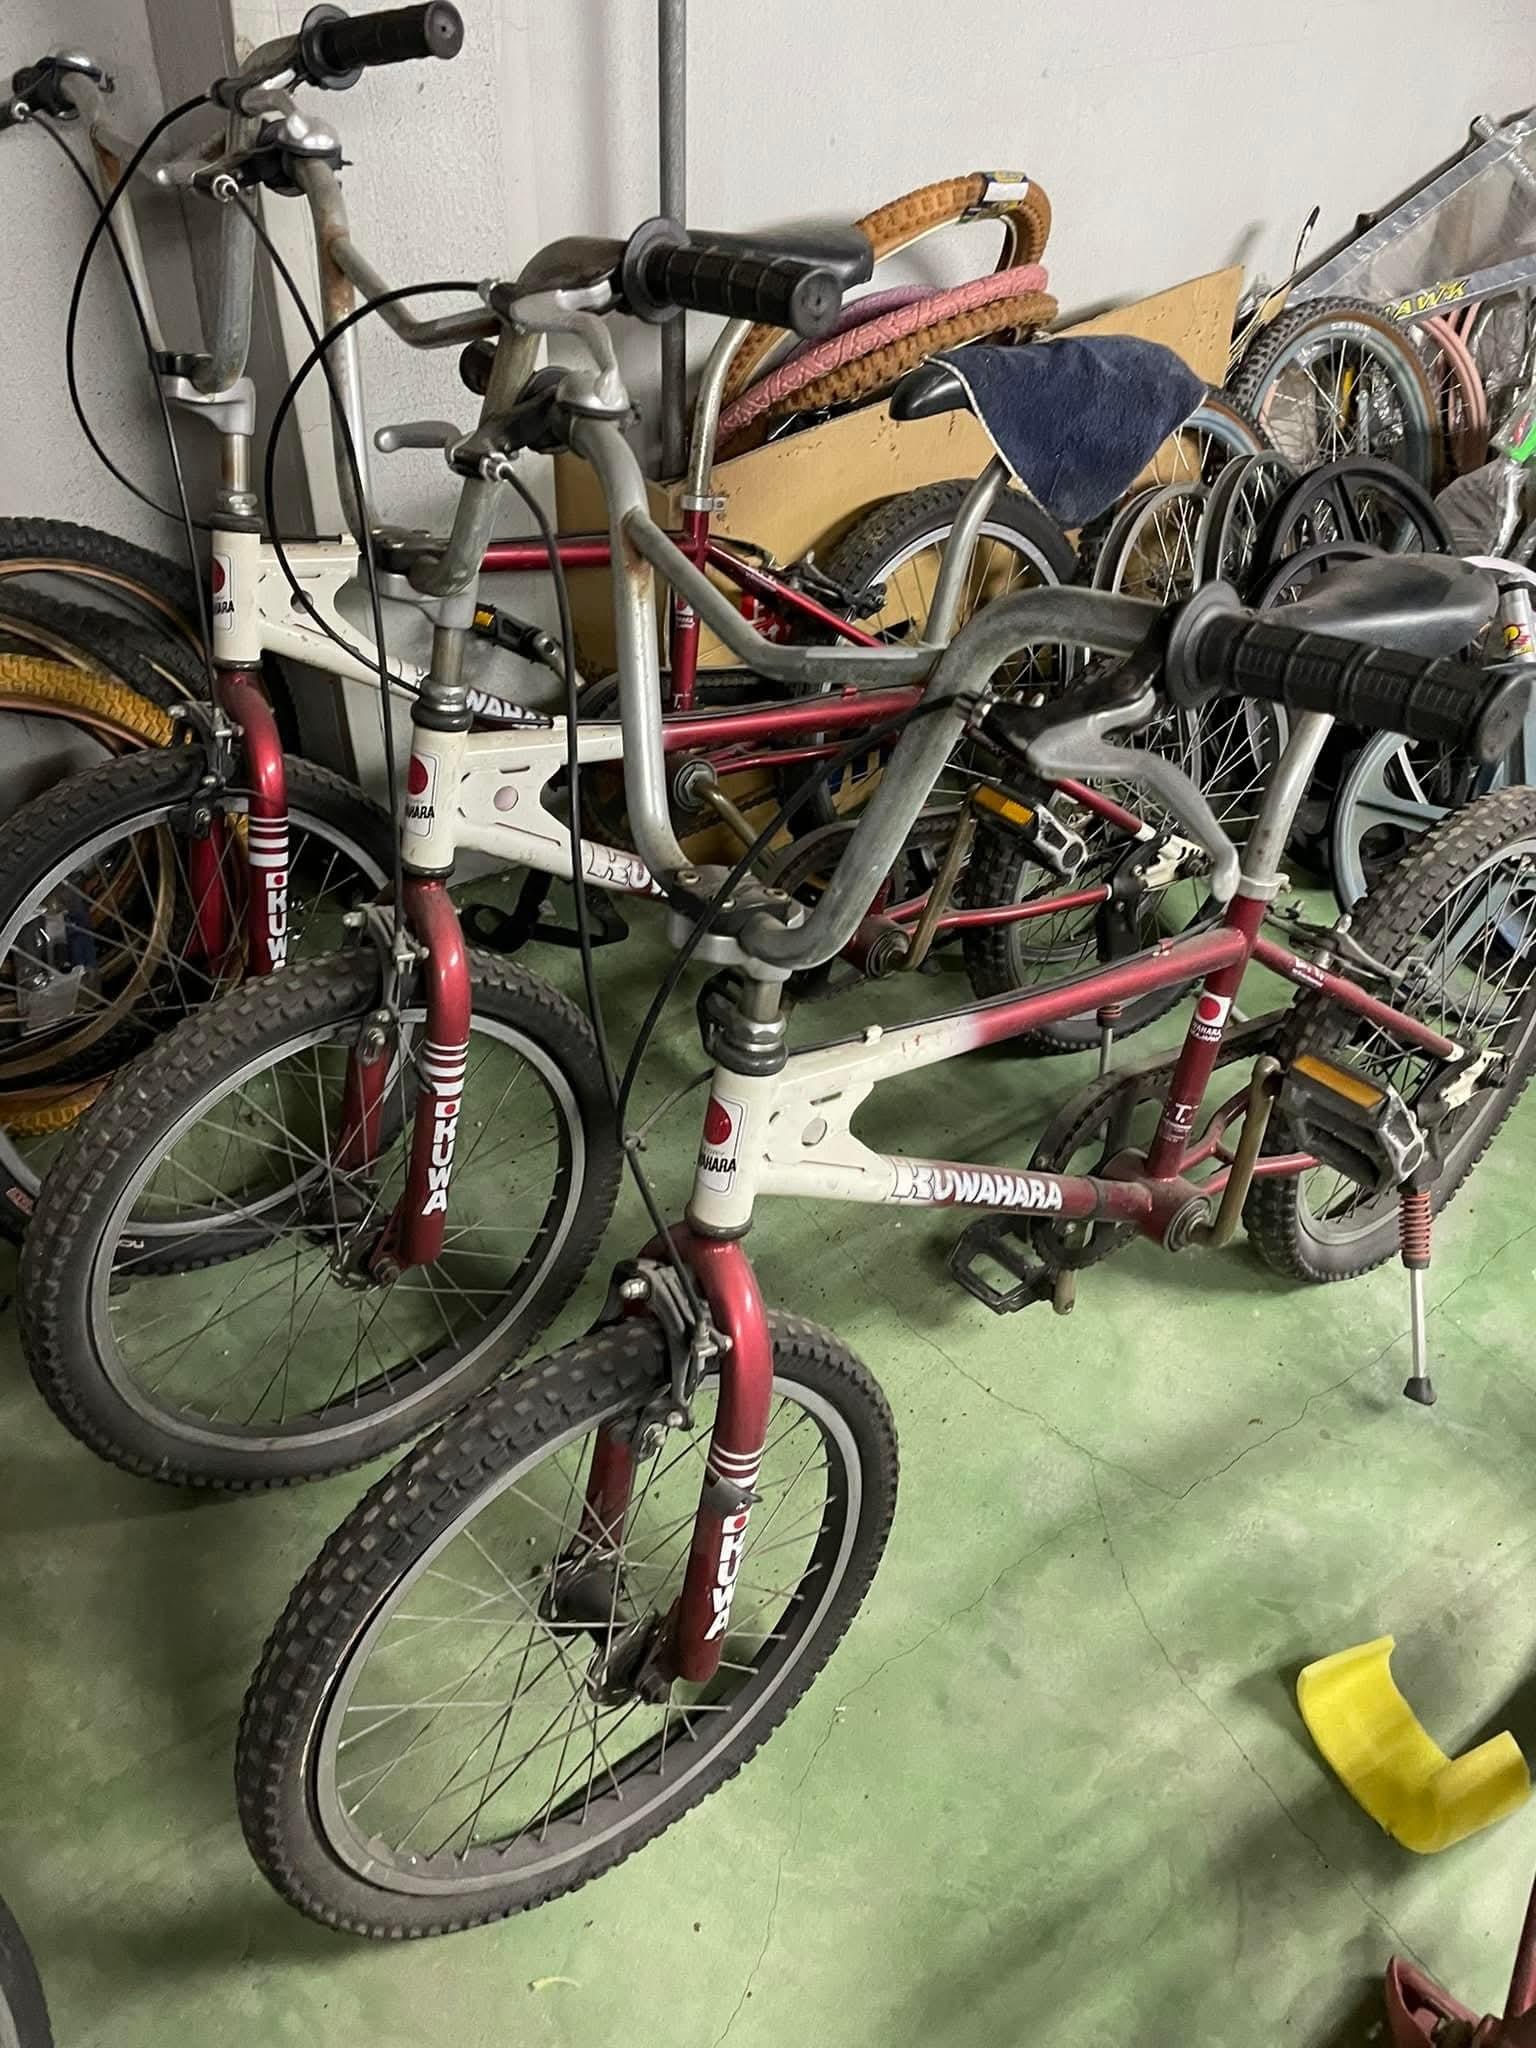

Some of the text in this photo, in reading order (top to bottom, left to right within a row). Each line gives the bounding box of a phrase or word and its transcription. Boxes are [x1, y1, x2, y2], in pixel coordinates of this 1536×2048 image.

[421, 1115, 459, 1216] KUWA
[889, 1161, 1063, 1211] KUWAHARA
[703, 1530, 746, 1638] KUWA
